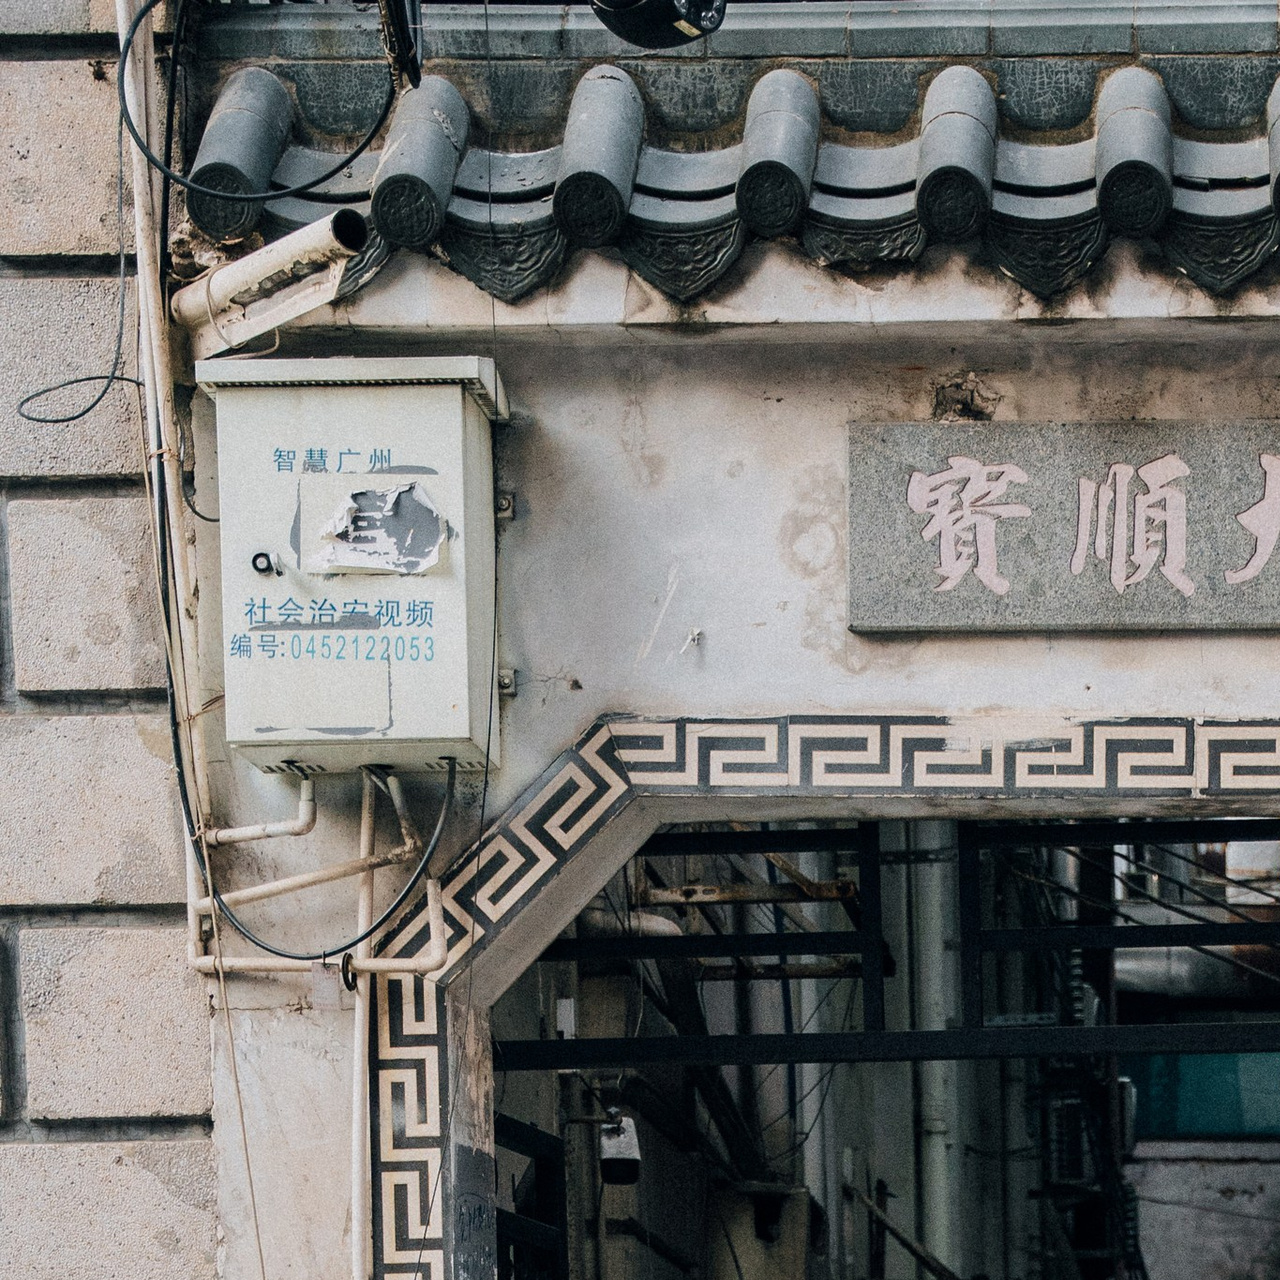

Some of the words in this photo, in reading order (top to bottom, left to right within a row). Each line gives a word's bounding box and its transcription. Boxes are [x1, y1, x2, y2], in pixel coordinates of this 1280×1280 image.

[273, 447, 391, 473] 智慧广州
[244, 597, 434, 628] 社会治安视频
